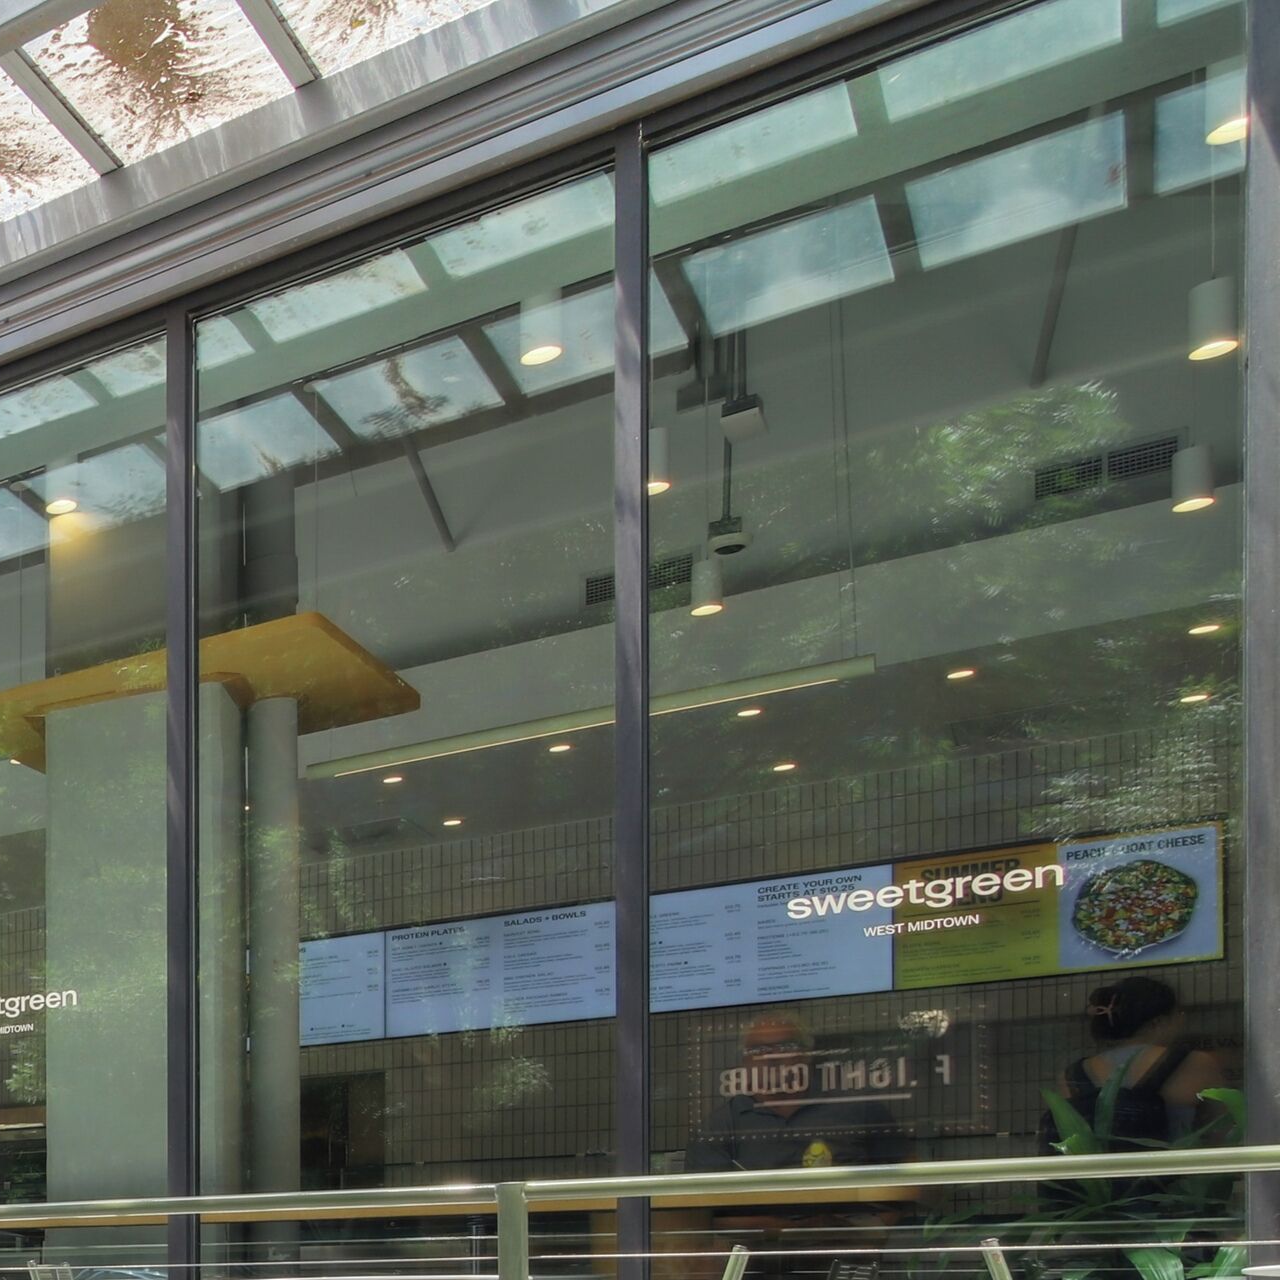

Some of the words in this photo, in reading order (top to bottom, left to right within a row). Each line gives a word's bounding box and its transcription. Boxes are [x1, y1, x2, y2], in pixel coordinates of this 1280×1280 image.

[1157, 833, 1206, 850] CHEESE
[757, 882, 800, 894] CREATE
[802, 879, 833, 889] YOUR
[835, 875, 862, 885] OWN
[757, 890, 801, 902] STARTS
[803, 888, 816, 897] AT
[819, 883, 855, 895] $10.25
[787, 863, 1065, 919] sweetgreen
[503, 916, 543, 927] SALADS
[551, 910, 587, 921] BOWLS
[863, 923, 904, 937] WEST
[907, 914, 980, 933] MIDTOWN
[391, 931, 430, 942] PROTEIN
